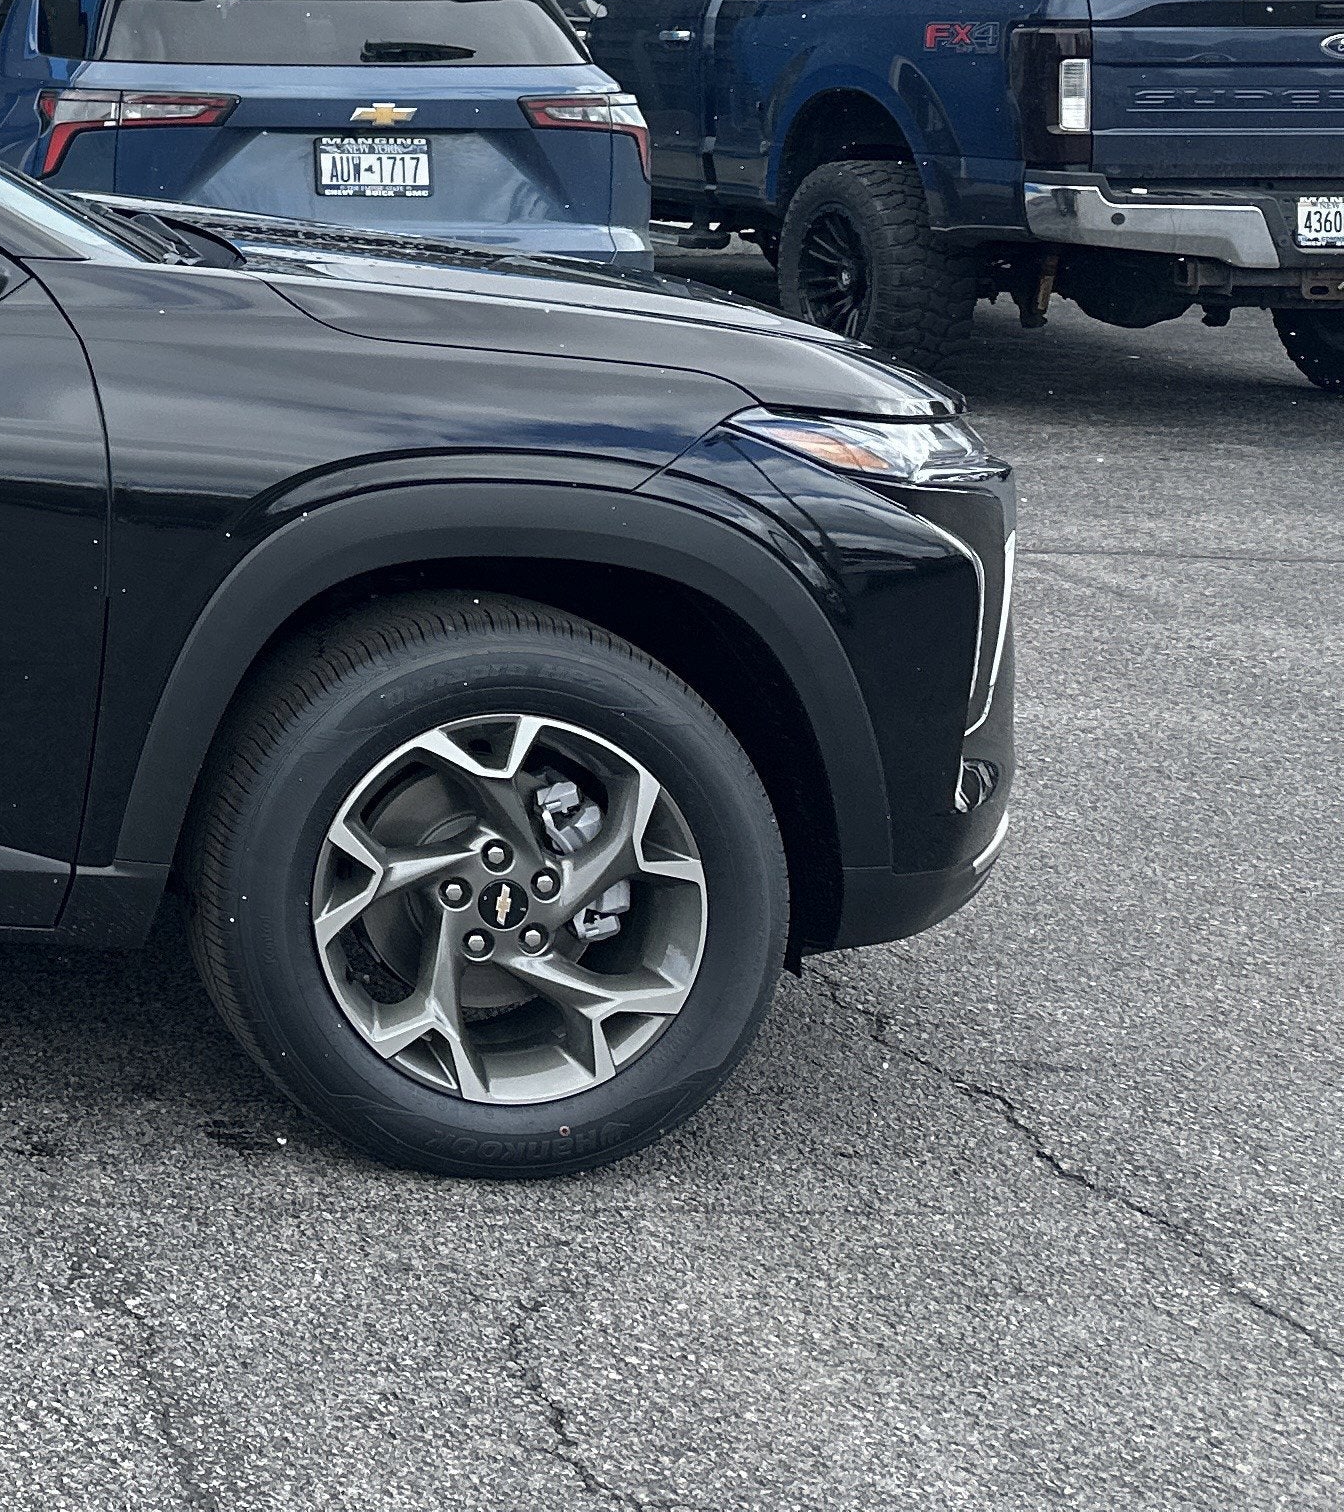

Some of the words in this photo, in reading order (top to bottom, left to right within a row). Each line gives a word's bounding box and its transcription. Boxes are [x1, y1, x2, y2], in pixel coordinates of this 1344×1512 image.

[924, 21, 1000, 51] FX4
[321, 137, 427, 145] MANGINO
[344, 144, 370, 153] NEW
[373, 144, 403, 154] YORK
